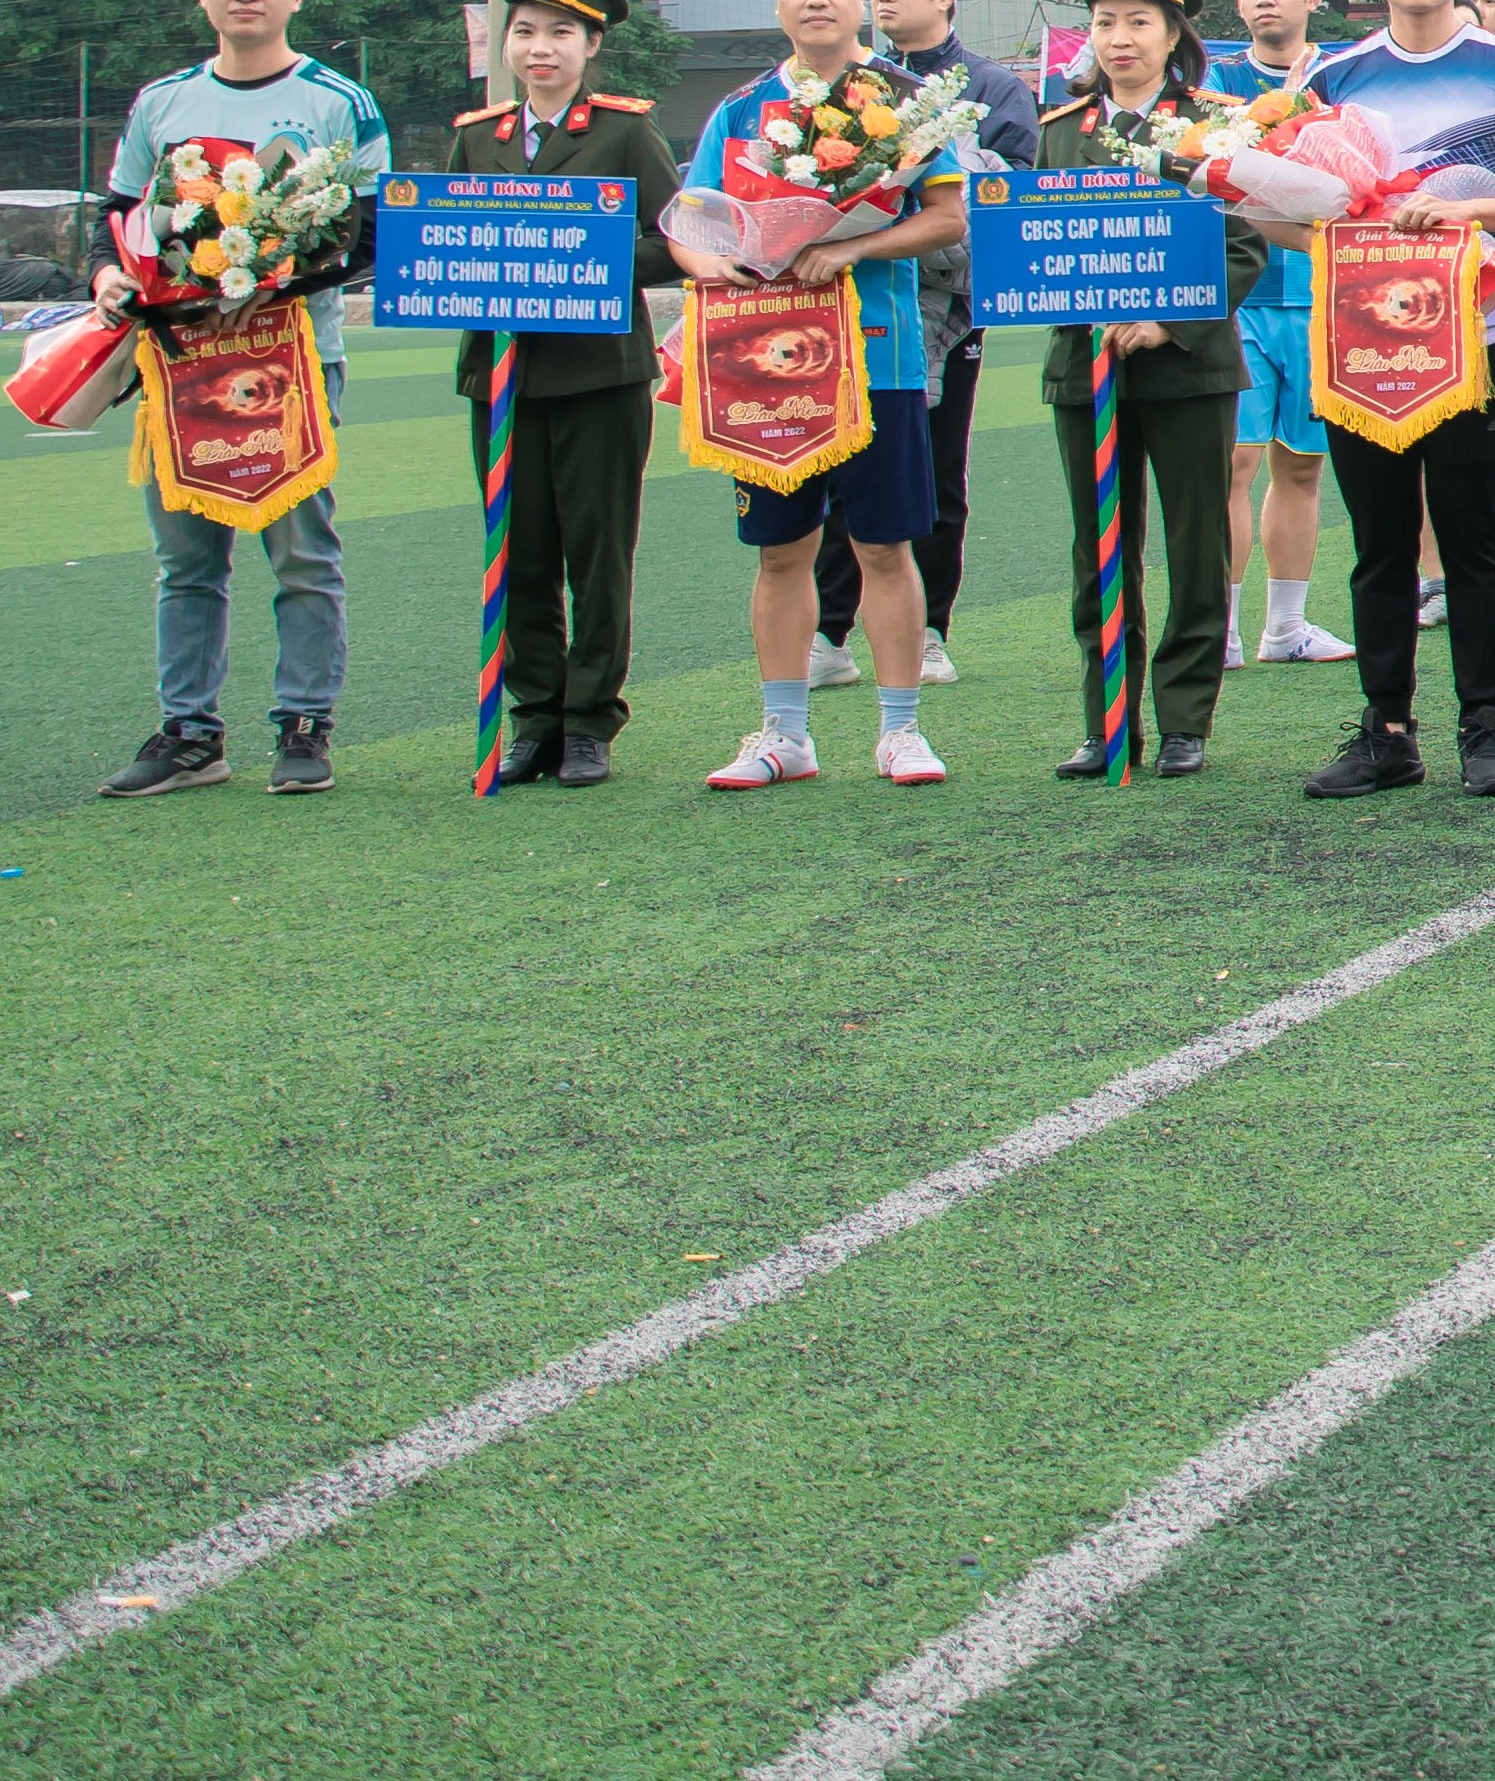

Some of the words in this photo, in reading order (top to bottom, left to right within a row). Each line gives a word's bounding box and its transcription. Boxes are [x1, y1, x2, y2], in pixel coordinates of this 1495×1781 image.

[422, 225, 465, 246] CBCS
[471, 223, 498, 250] ĐỘI
[504, 219, 547, 248] TỔNG
[552, 227, 585, 252] HỢP
[1022, 220, 1062, 241] CBCS
[1068, 218, 1098, 239] CAP
[1103, 217, 1139, 238] NAM
[1144, 209, 1170, 236] HẢI
[415, 257, 442, 284] ĐỘI
[448, 258, 498, 282] CHÍNH
[504, 262, 528, 286] TRỊ
[534, 260, 567, 288] HẬU
[1045, 255, 1075, 276] CAP
[1080, 250, 1131, 274] TRÀNG
[1136, 248, 1165, 272] CÁT
[438, 293, 482, 317] CÔNG
[487, 298, 510, 317] AN
[516, 298, 549, 318] KCN
[555, 295, 594, 319] ĐÌNH
[600, 297, 621, 320] VŨ
[997, 289, 1022, 316] ĐỘI
[1027, 285, 1069, 312] CẢNH
[1075, 286, 1103, 310] SÁT
[1108, 288, 1149, 308] PCCC
[1156, 288, 1167, 307] &
[1173, 286, 1215, 306] CNCH
[1397, 381, 1416, 390] 2022
